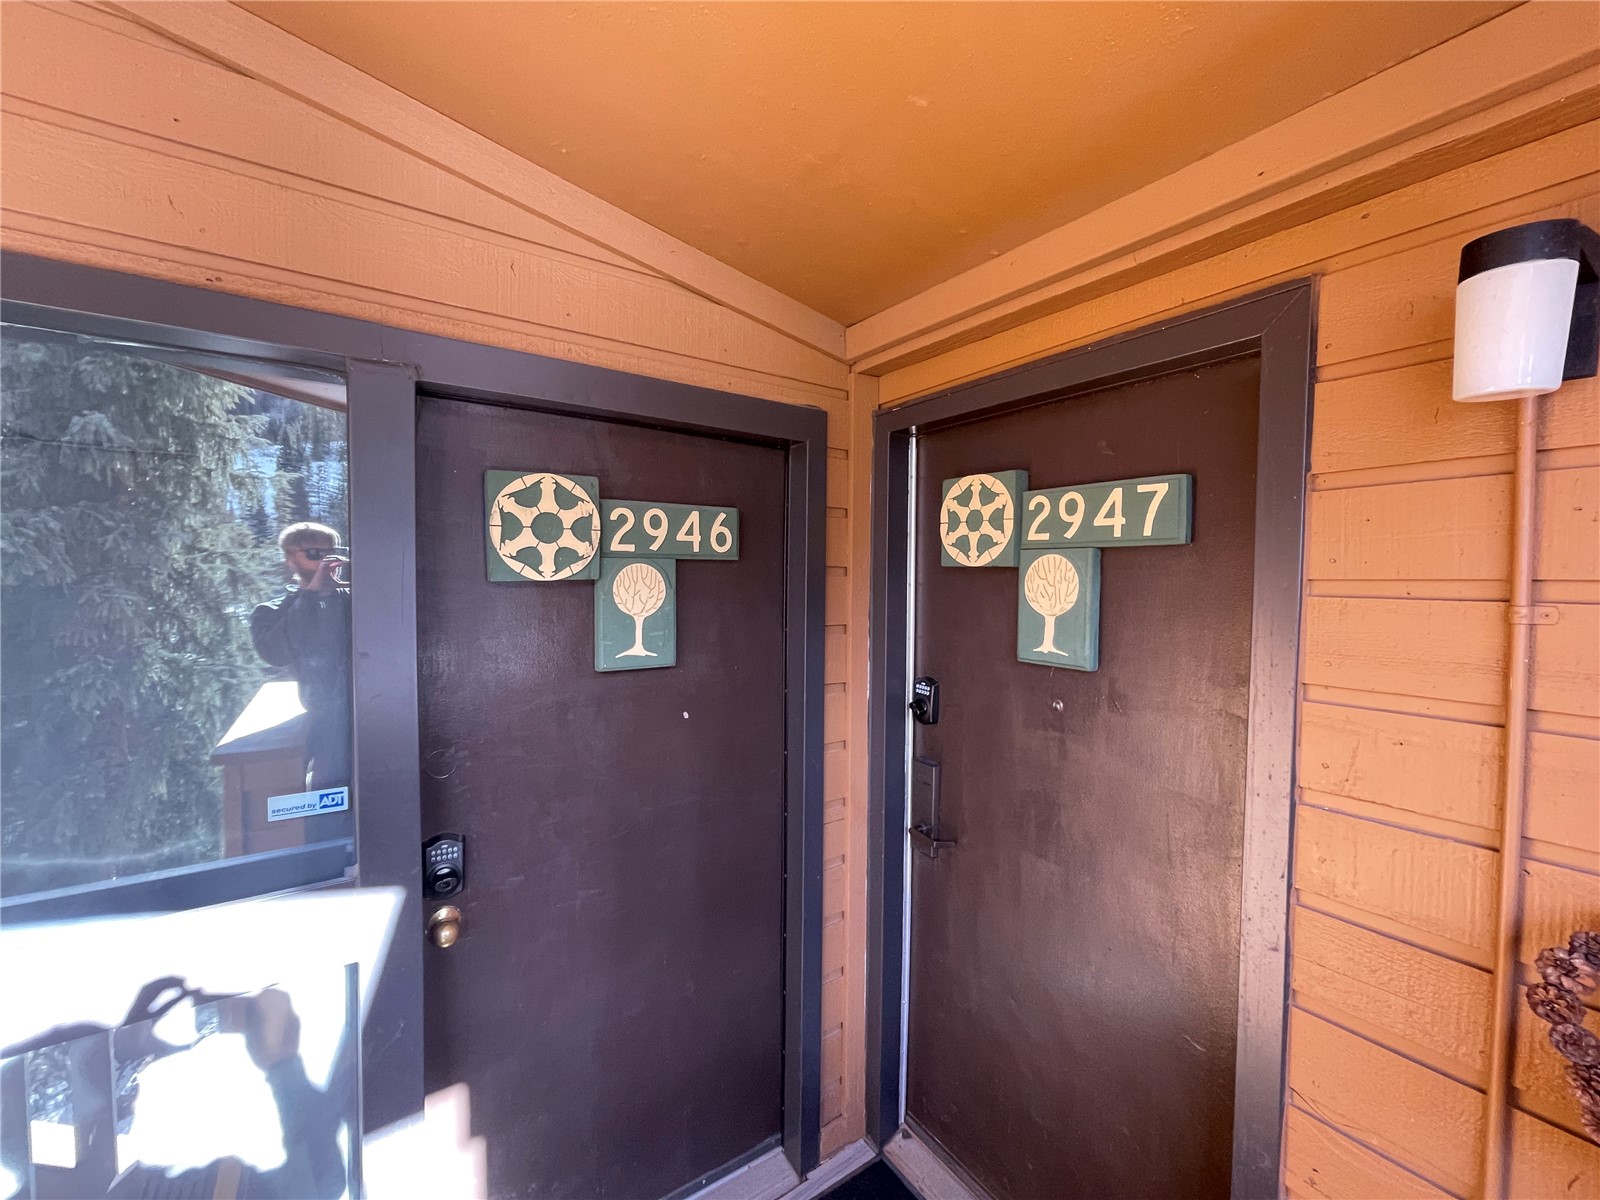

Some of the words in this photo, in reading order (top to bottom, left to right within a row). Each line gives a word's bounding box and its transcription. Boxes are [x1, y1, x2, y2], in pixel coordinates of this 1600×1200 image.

[610, 507, 733, 554] 2946
[1027, 482, 1169, 541] 2947
[271, 804, 306, 814] secured
[319, 793, 344, 807] ADT
